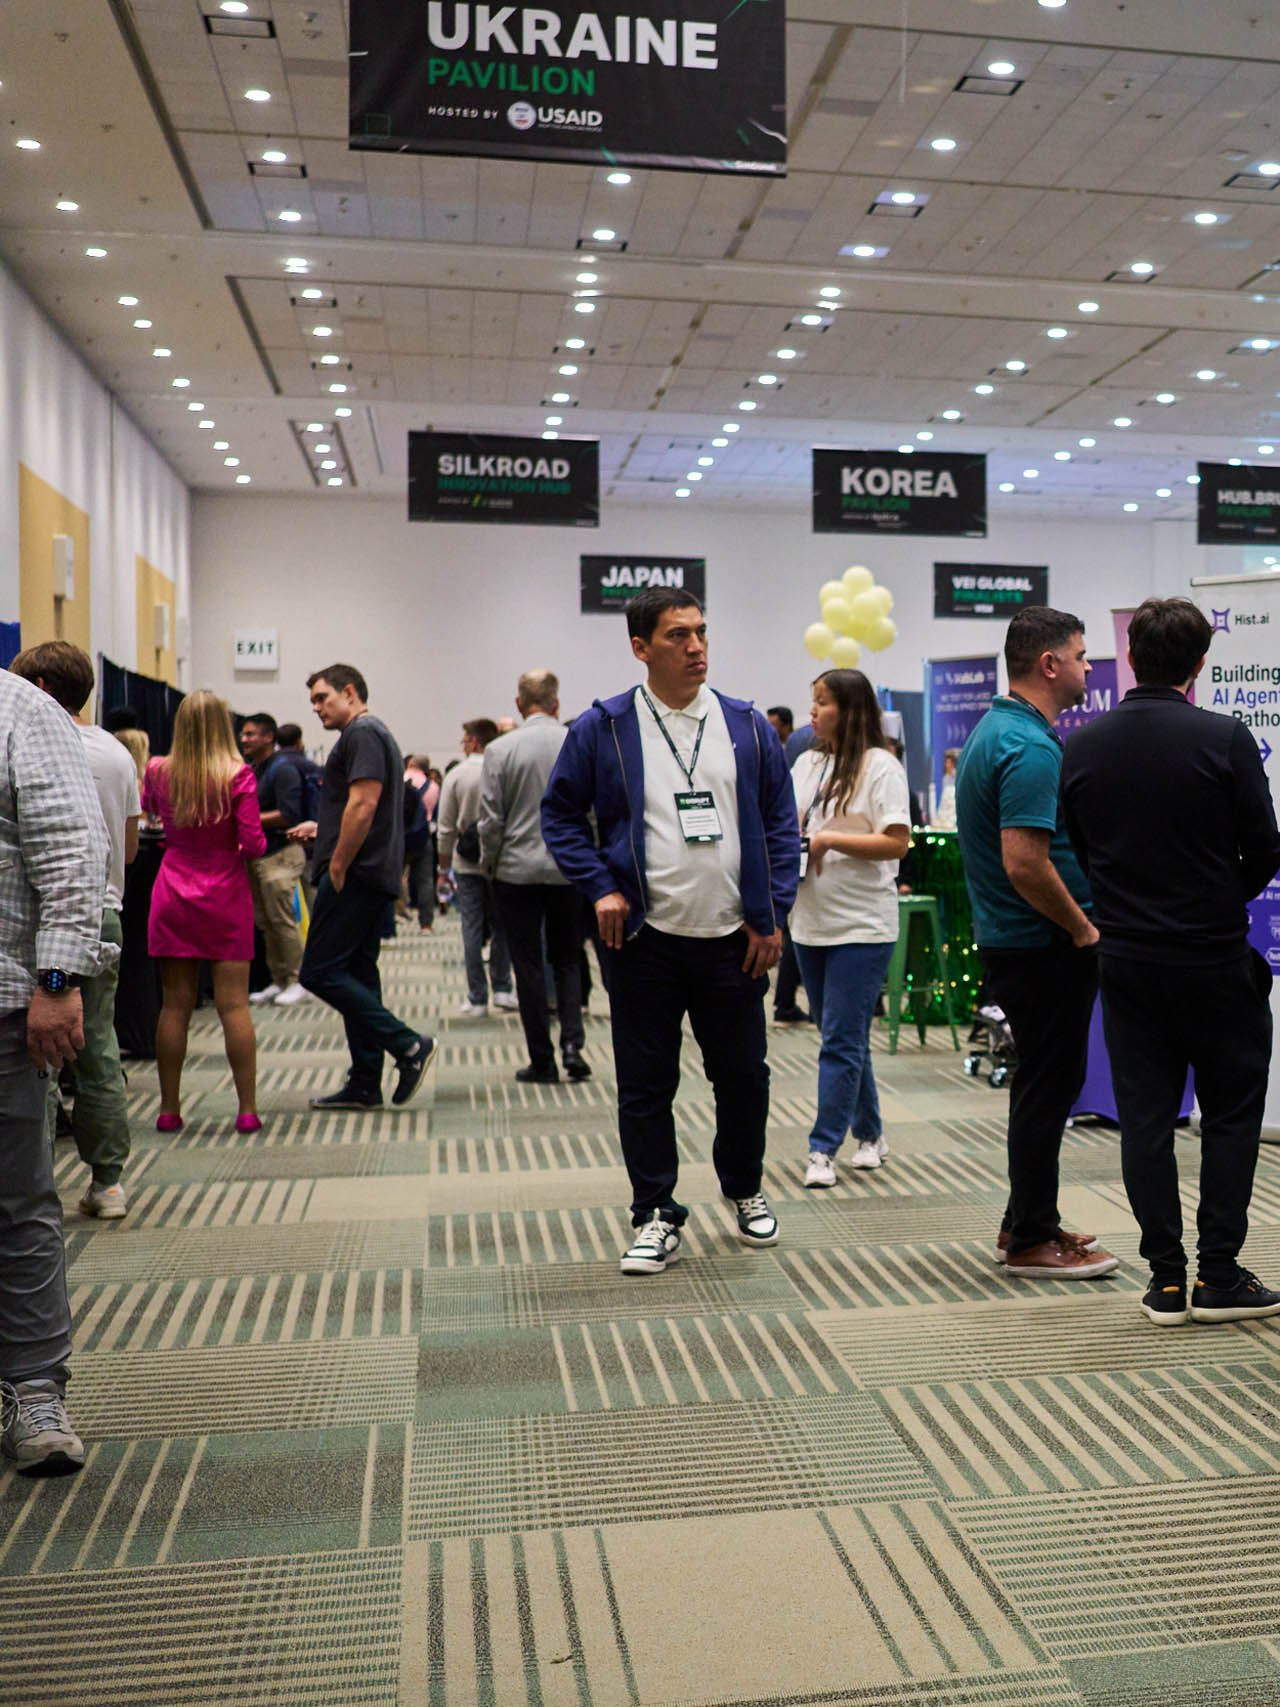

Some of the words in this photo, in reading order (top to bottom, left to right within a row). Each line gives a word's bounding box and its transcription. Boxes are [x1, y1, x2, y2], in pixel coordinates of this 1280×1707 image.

[427, 1, 719, 71] UKRAINE
[427, 58, 595, 97] PAVILION
[428, 106, 479, 119] HOSTED
[483, 110, 499, 120] BY
[537, 106, 603, 127] USAID
[437, 454, 570, 479] SILKROAD
[437, 477, 535, 493] INNOVATION
[841, 468, 957, 499] KOREA
[601, 566, 684, 588] JAPAN
[977, 576, 1033, 591] GLOBAL
[1235, 613, 1270, 625] Hist.ai
[237, 641, 273, 656] EXIT
[1213, 688, 1229, 706] AI
